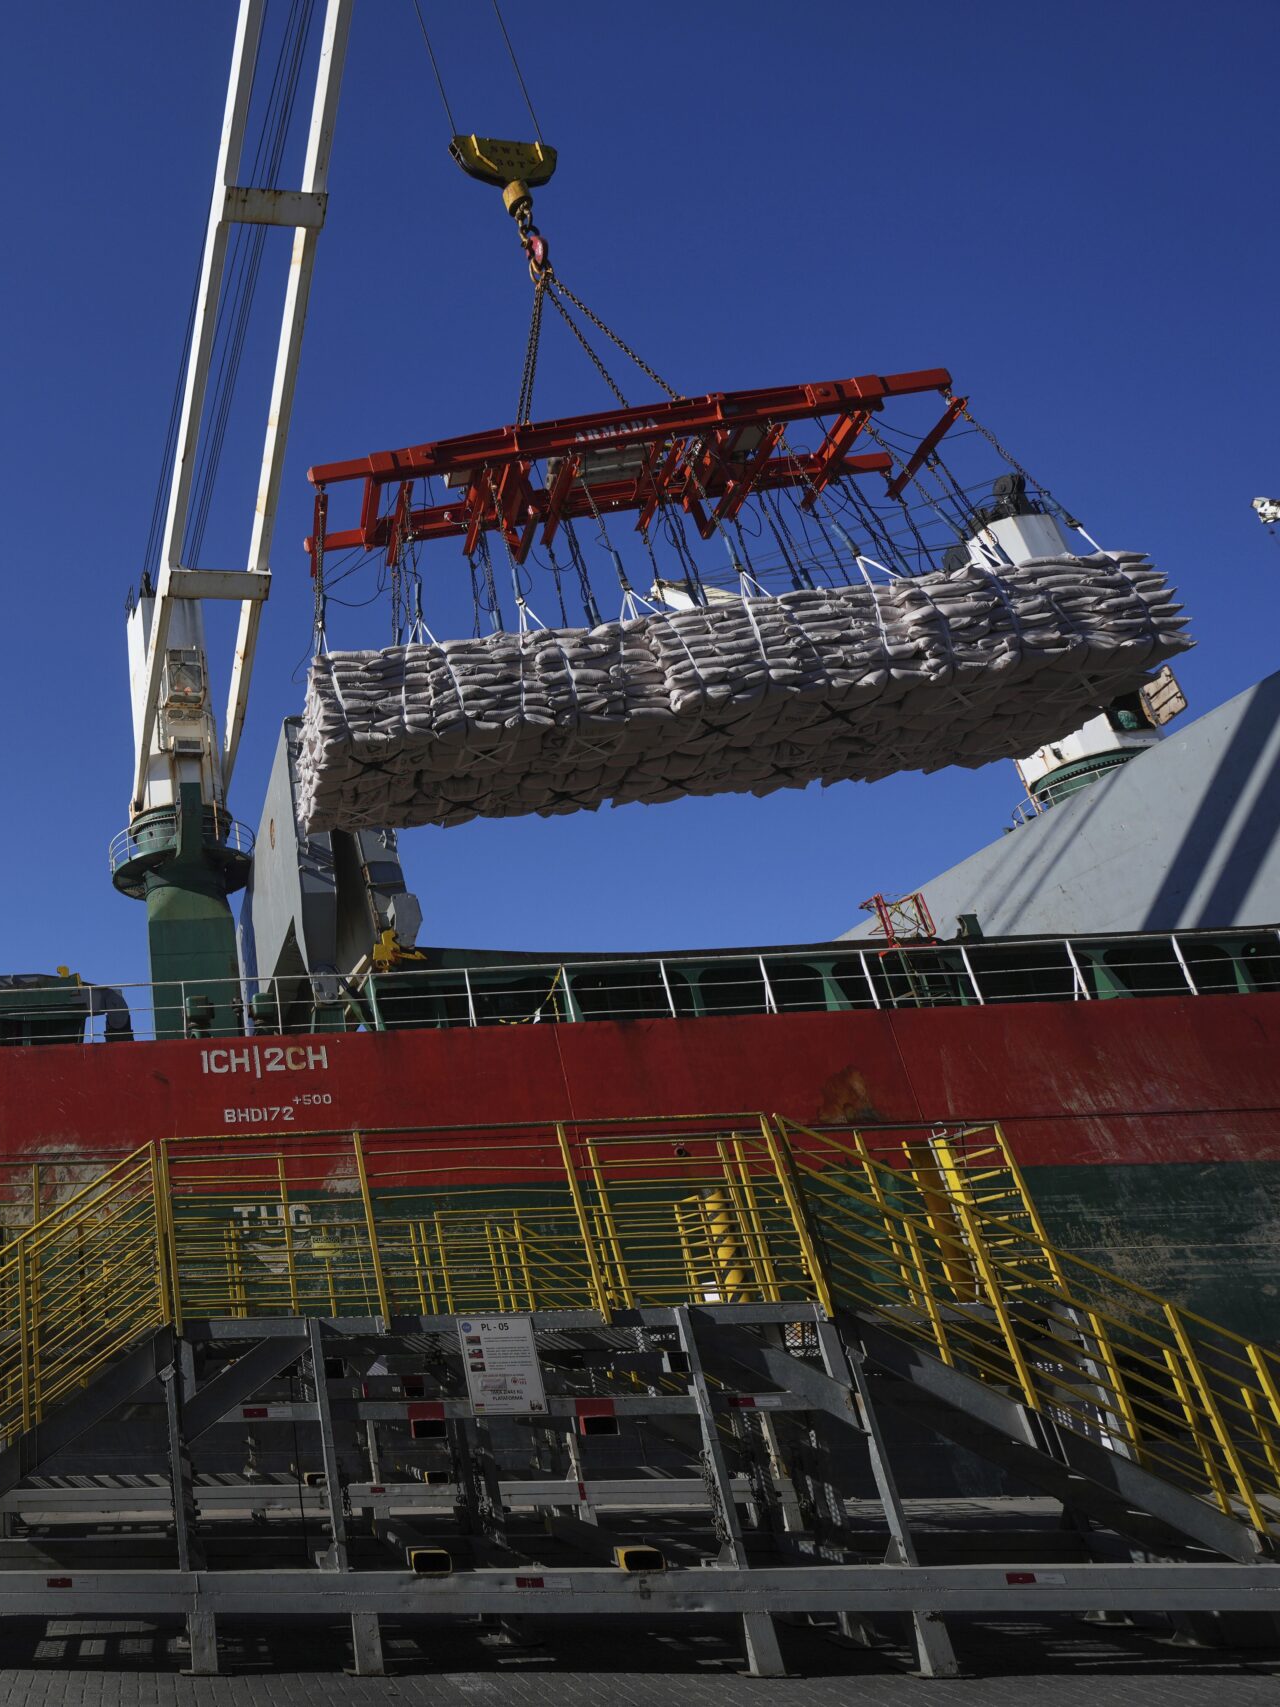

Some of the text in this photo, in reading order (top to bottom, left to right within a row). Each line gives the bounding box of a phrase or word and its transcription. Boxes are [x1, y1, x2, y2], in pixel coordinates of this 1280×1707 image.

[575, 418, 659, 442] ARMADA
[232, 1203, 312, 1235] TUG
[481, 1323, 492, 1331] PL
[498, 1323, 509, 1331] 05
